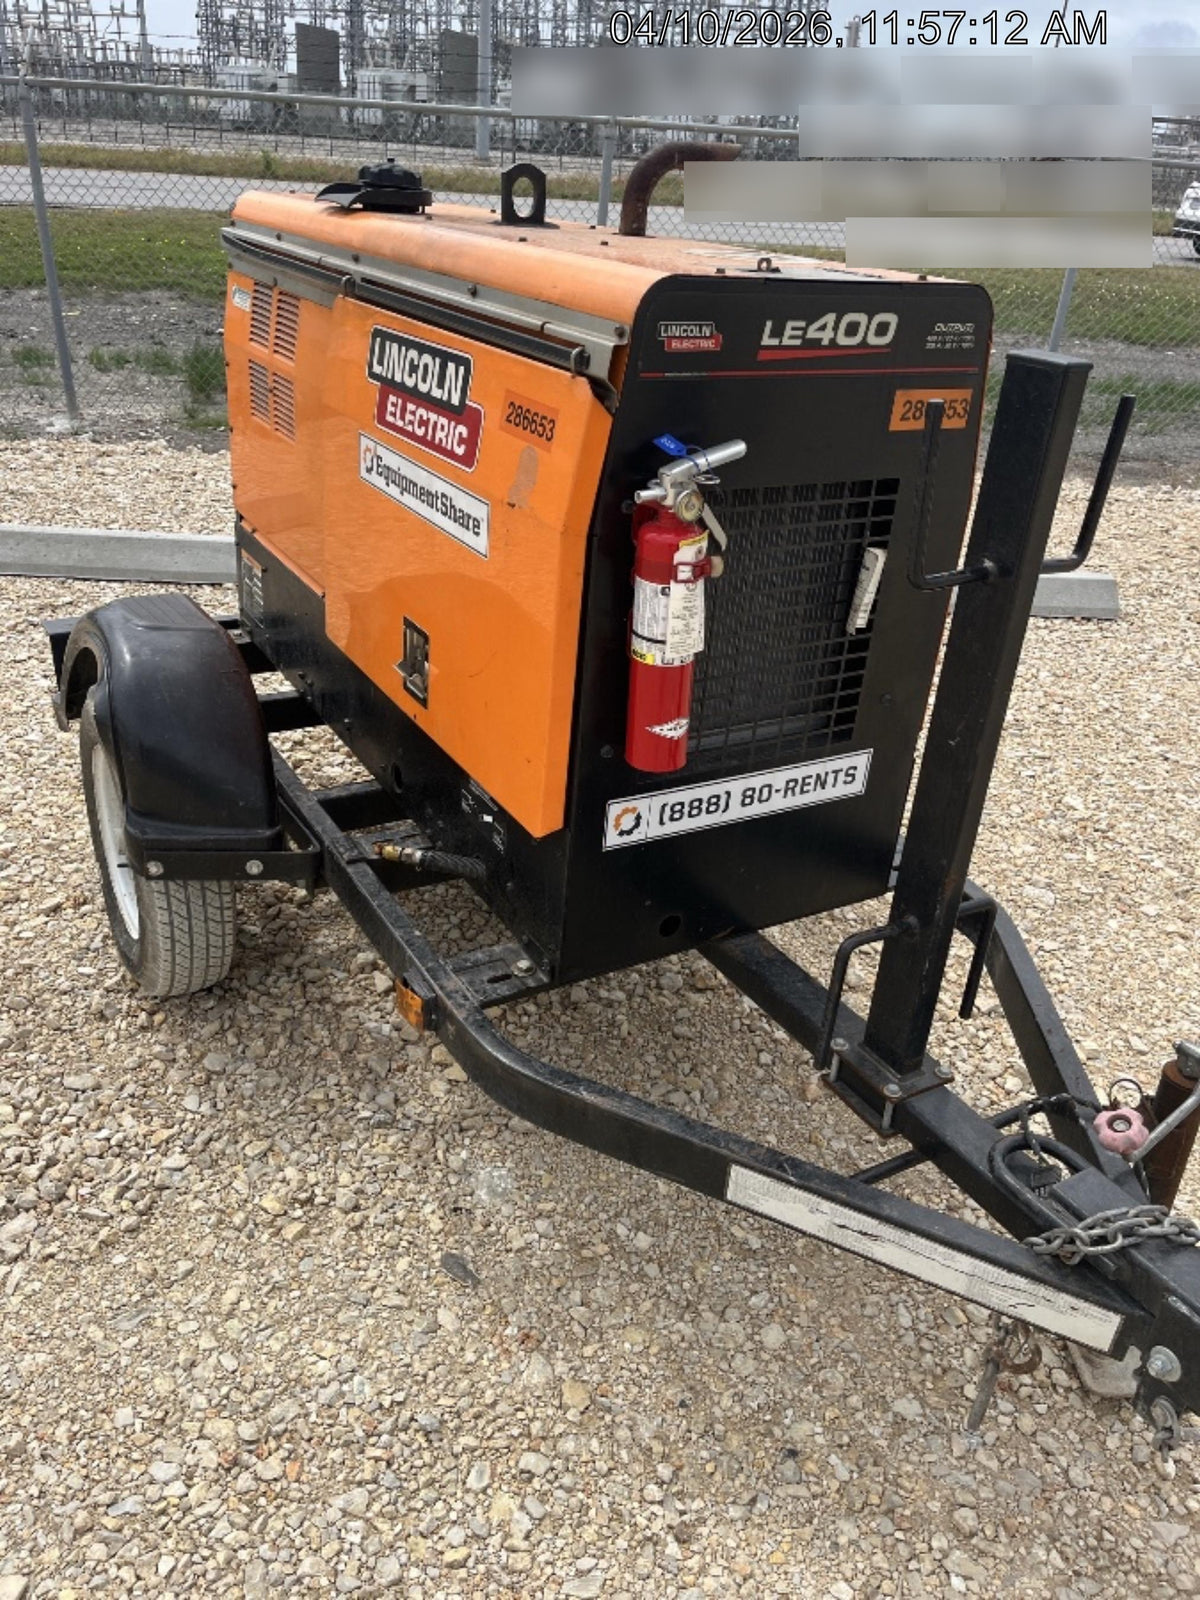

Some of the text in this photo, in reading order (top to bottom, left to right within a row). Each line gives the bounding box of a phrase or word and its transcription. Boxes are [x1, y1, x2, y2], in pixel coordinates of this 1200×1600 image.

[660, 324, 711, 337] LINCOLN
[671, 338, 716, 349] ELECTRIC
[760, 312, 899, 346] LE400
[371, 337, 466, 407] LINCOLN
[385, 394, 469, 456] ELECTRIC
[505, 401, 556, 442] 286653
[376, 454, 481, 537] EquipmentShare
[658, 766, 858, 826] (888) 80-RENTS
